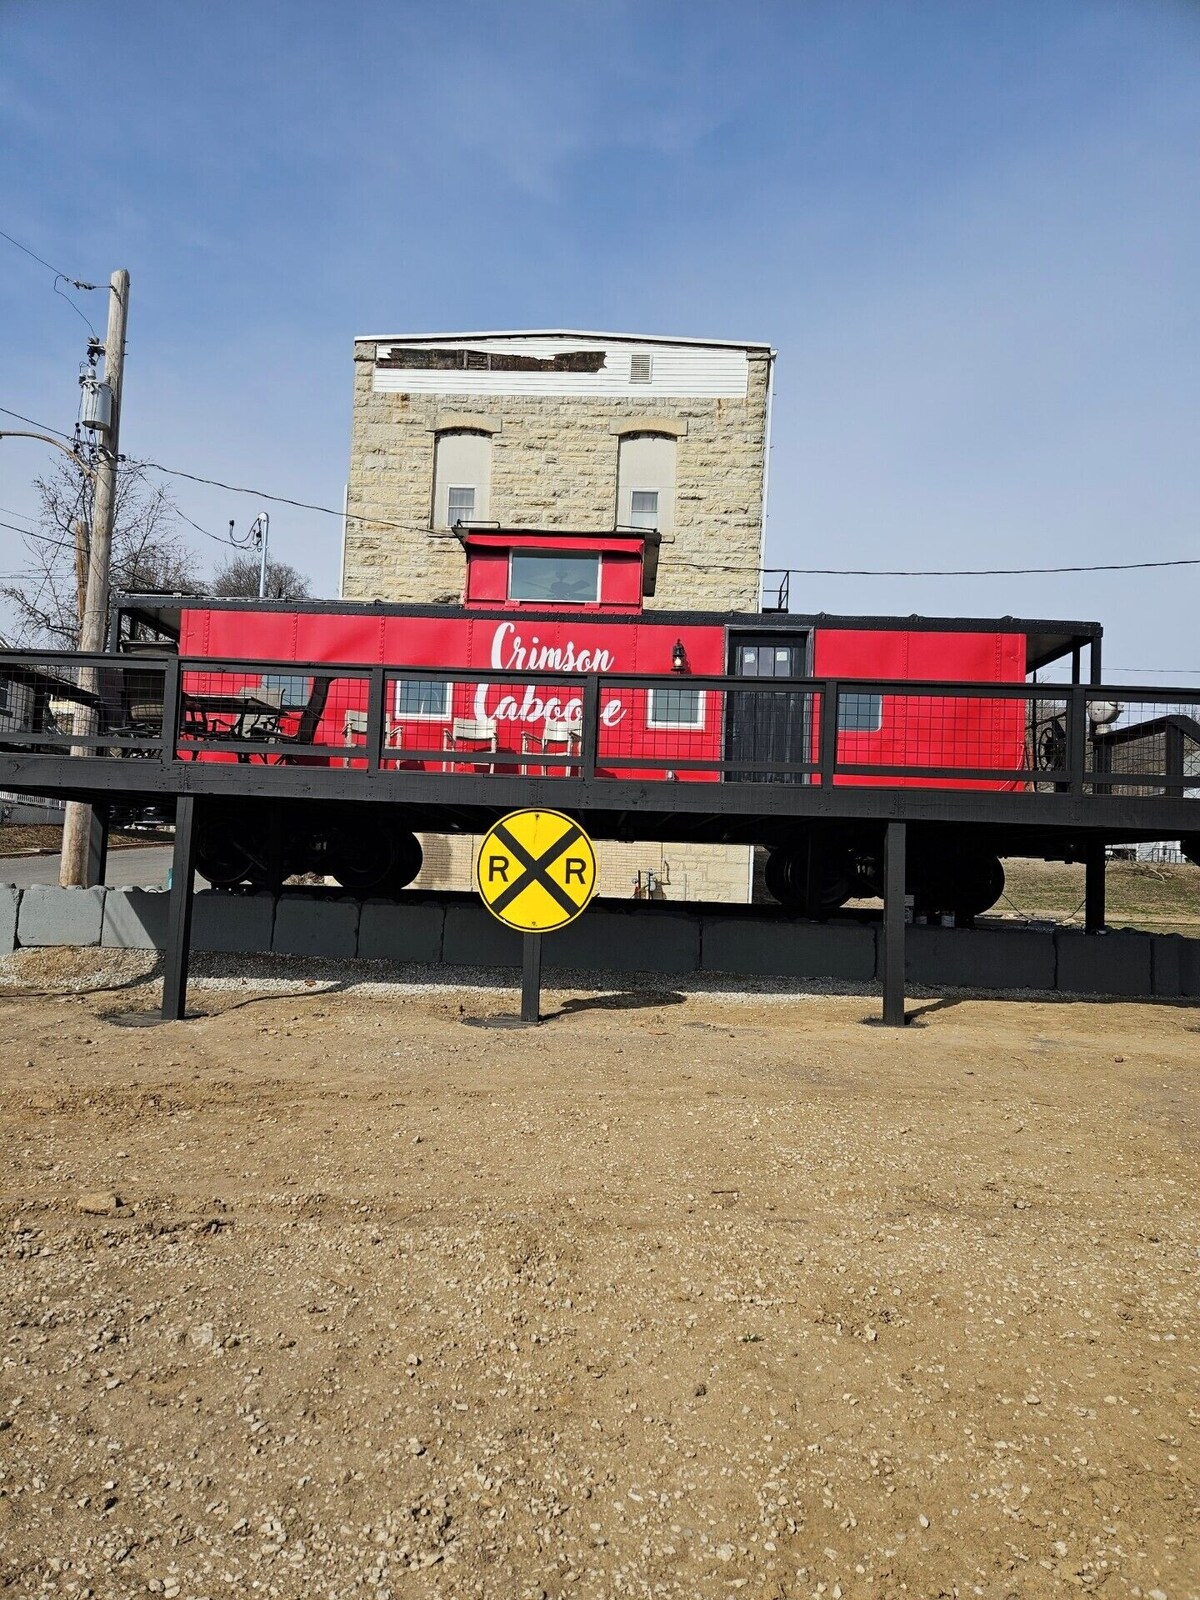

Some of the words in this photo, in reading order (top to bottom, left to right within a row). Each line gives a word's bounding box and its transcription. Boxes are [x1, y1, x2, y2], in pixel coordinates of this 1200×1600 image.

[491, 622, 615, 673] Crimson
[473, 683, 627, 727] Cabooe
[488, 855, 510, 882] R
[565, 858, 586, 884] R
